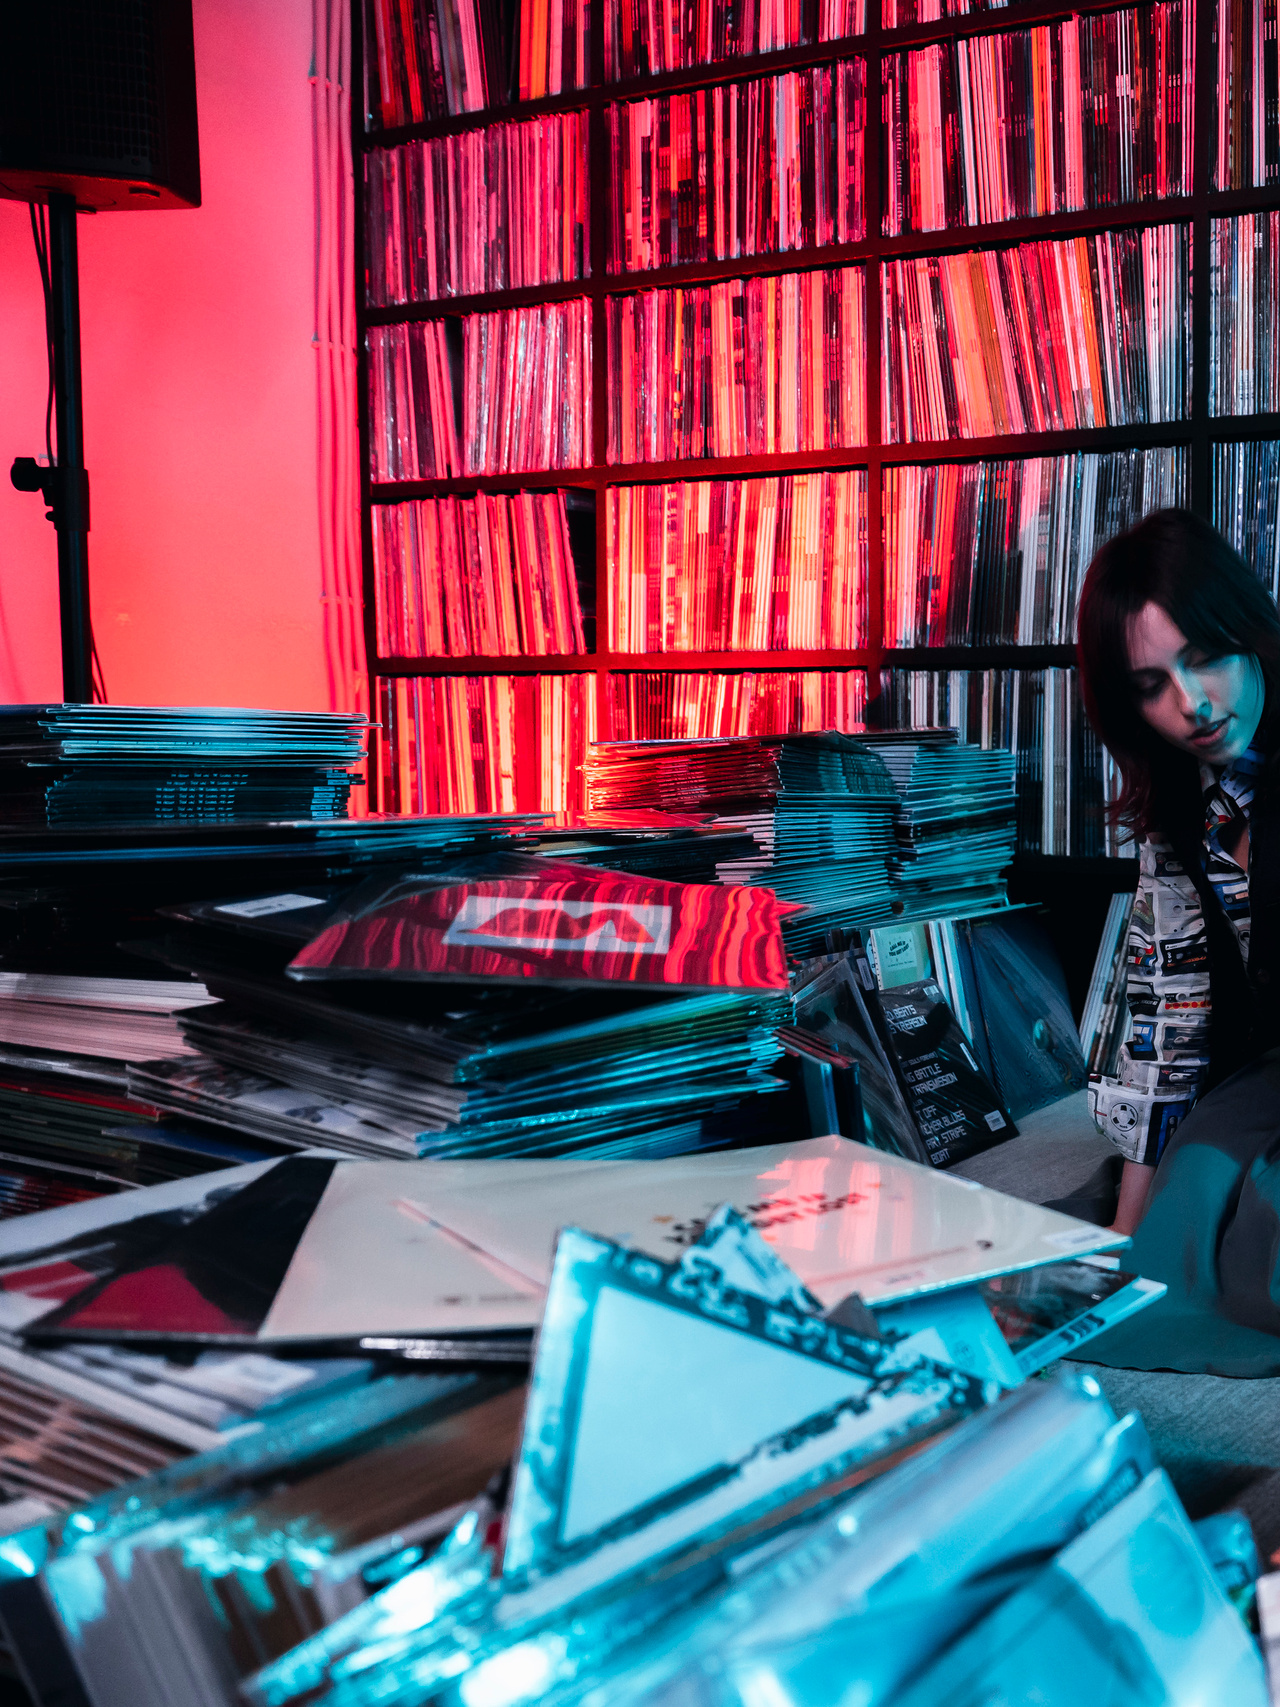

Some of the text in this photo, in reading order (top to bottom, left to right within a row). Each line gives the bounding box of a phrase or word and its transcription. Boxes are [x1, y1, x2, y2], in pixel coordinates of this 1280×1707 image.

[892, 1004, 917, 1019] BEATS
[896, 1015, 928, 1032] TREASON
[913, 1063, 943, 1081] BATTLE
[922, 1104, 937, 1119] OFF
[941, 1109, 966, 1127] BLUES
[940, 1125, 967, 1144] STRIPE
[930, 1148, 951, 1165] BOAT
